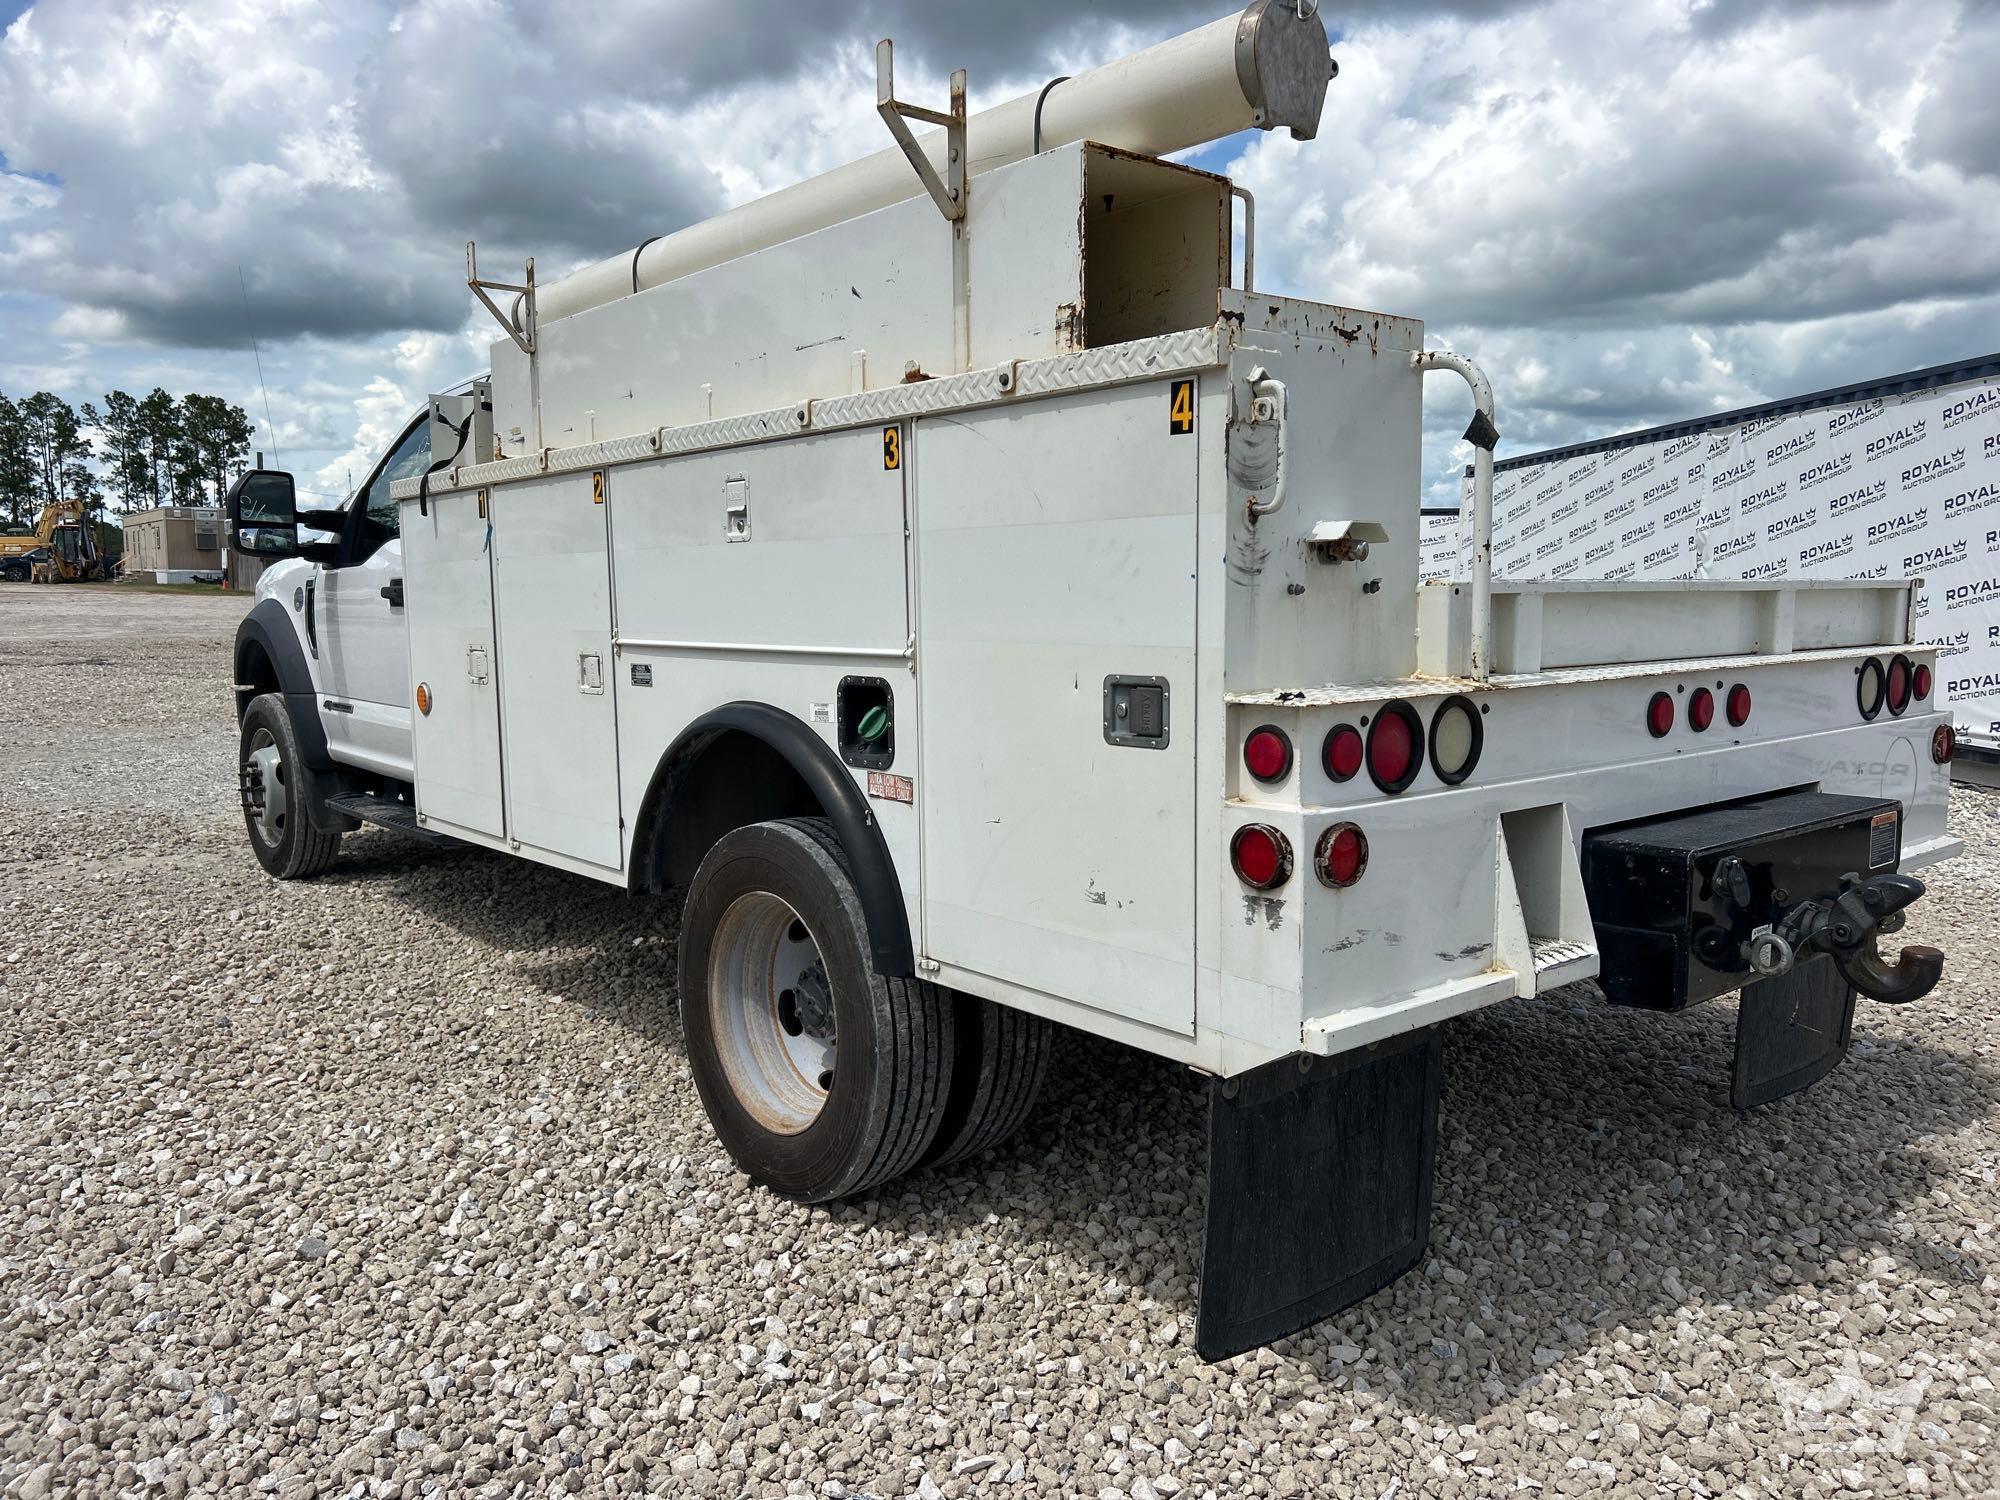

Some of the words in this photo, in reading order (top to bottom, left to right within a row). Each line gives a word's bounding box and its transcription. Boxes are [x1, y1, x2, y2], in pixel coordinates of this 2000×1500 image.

[1171, 384, 1192, 431] 4
[1943, 390, 1996, 420] ROYAL
[1829, 404, 1872, 430] ROYAL
[1830, 421, 1858, 438] AUCTION
[1860, 409, 1884, 424] GROUP
[1944, 409, 1980, 430] AUCTION
[1742, 429, 1765, 444] AUCTION
[1766, 417, 1786, 430] GROUP
[1866, 427, 1912, 454] ROYAL
[885, 429, 899, 468] 3
[1664, 437, 1692, 458] ROYAL
[1767, 436, 1804, 460] ROYAL
[1768, 452, 1793, 467] AUCTION
[1794, 441, 1815, 455] GROUP
[1867, 446, 1898, 463] AUCTION
[1900, 433, 1926, 448] GROUP
[1569, 466, 1590, 482] ROYAL
[1622, 461, 1648, 481] ROYAL
[1713, 464, 1746, 486] ROYAL
[1800, 459, 1840, 484] ROYAL
[1800, 476, 1827, 491] AUCTION
[1829, 465, 1851, 479] GROUP
[1902, 456, 1951, 482] ROYAL
[1902, 473, 1936, 490] AUCTION
[1937, 462, 1965, 477] GROUP
[594, 473, 603, 502] 2
[1537, 485, 1557, 501] ROYAL
[1585, 484, 1610, 502] ROYAL
[1643, 481, 1671, 500] ROYAL
[1741, 487, 1776, 508] ROYAL
[1944, 484, 1999, 511] ROYAL
[1742, 503, 1765, 515] AUCTION
[1767, 493, 1786, 505] GROUP
[1830, 487, 1873, 510] ROYAL
[1831, 503, 1860, 518] AUCTION
[1862, 493, 1886, 506] GROUP
[1429, 516, 1457, 525] ROYAL
[1552, 504, 1572, 520] ROYAL
[1604, 503, 1628, 520] ROYAL
[1664, 504, 1693, 523] ROYAL
[1945, 502, 1982, 520] AUCTION
[1569, 523, 1590, 538] ROYAL
[1710, 517, 1730, 528] GROUP
[1768, 513, 1806, 534] ROYAL
[1768, 528, 1793, 542] AUCTION
[1794, 520, 1816, 532] GROUP
[1868, 514, 1914, 537] ROYAL
[1622, 525, 1648, 543] ROYAL
[1869, 530, 1900, 546] AUCTION
[1902, 521, 1928, 535] GROUP
[1433, 551, 1456, 559] ROYA
[1537, 540, 1557, 555] ROYAL
[1585, 544, 1608, 560] ROYAL
[1644, 547, 1671, 564] ROYAL
[1713, 536, 1746, 555] ROYAL
[1800, 540, 1841, 561] ROYAL
[1552, 561, 1572, 575] ROYAL
[1800, 555, 1829, 568] AUCTION
[1830, 547, 1853, 559] GROUP
[1904, 546, 1952, 569] ROYAL
[1904, 563, 1938, 577] AUCTION
[1939, 554, 1967, 567] GROUP
[1604, 565, 1628, 580] ROYAL
[1742, 562, 1777, 579] ROYAL
[1946, 578, 2000, 601] ROYAL
[1947, 596, 1984, 610] AUCTION
[1941, 647, 1969, 658] GROUP
[1948, 674, 2000, 692] ROYAL
[1949, 690, 1986, 701] AUCTION
